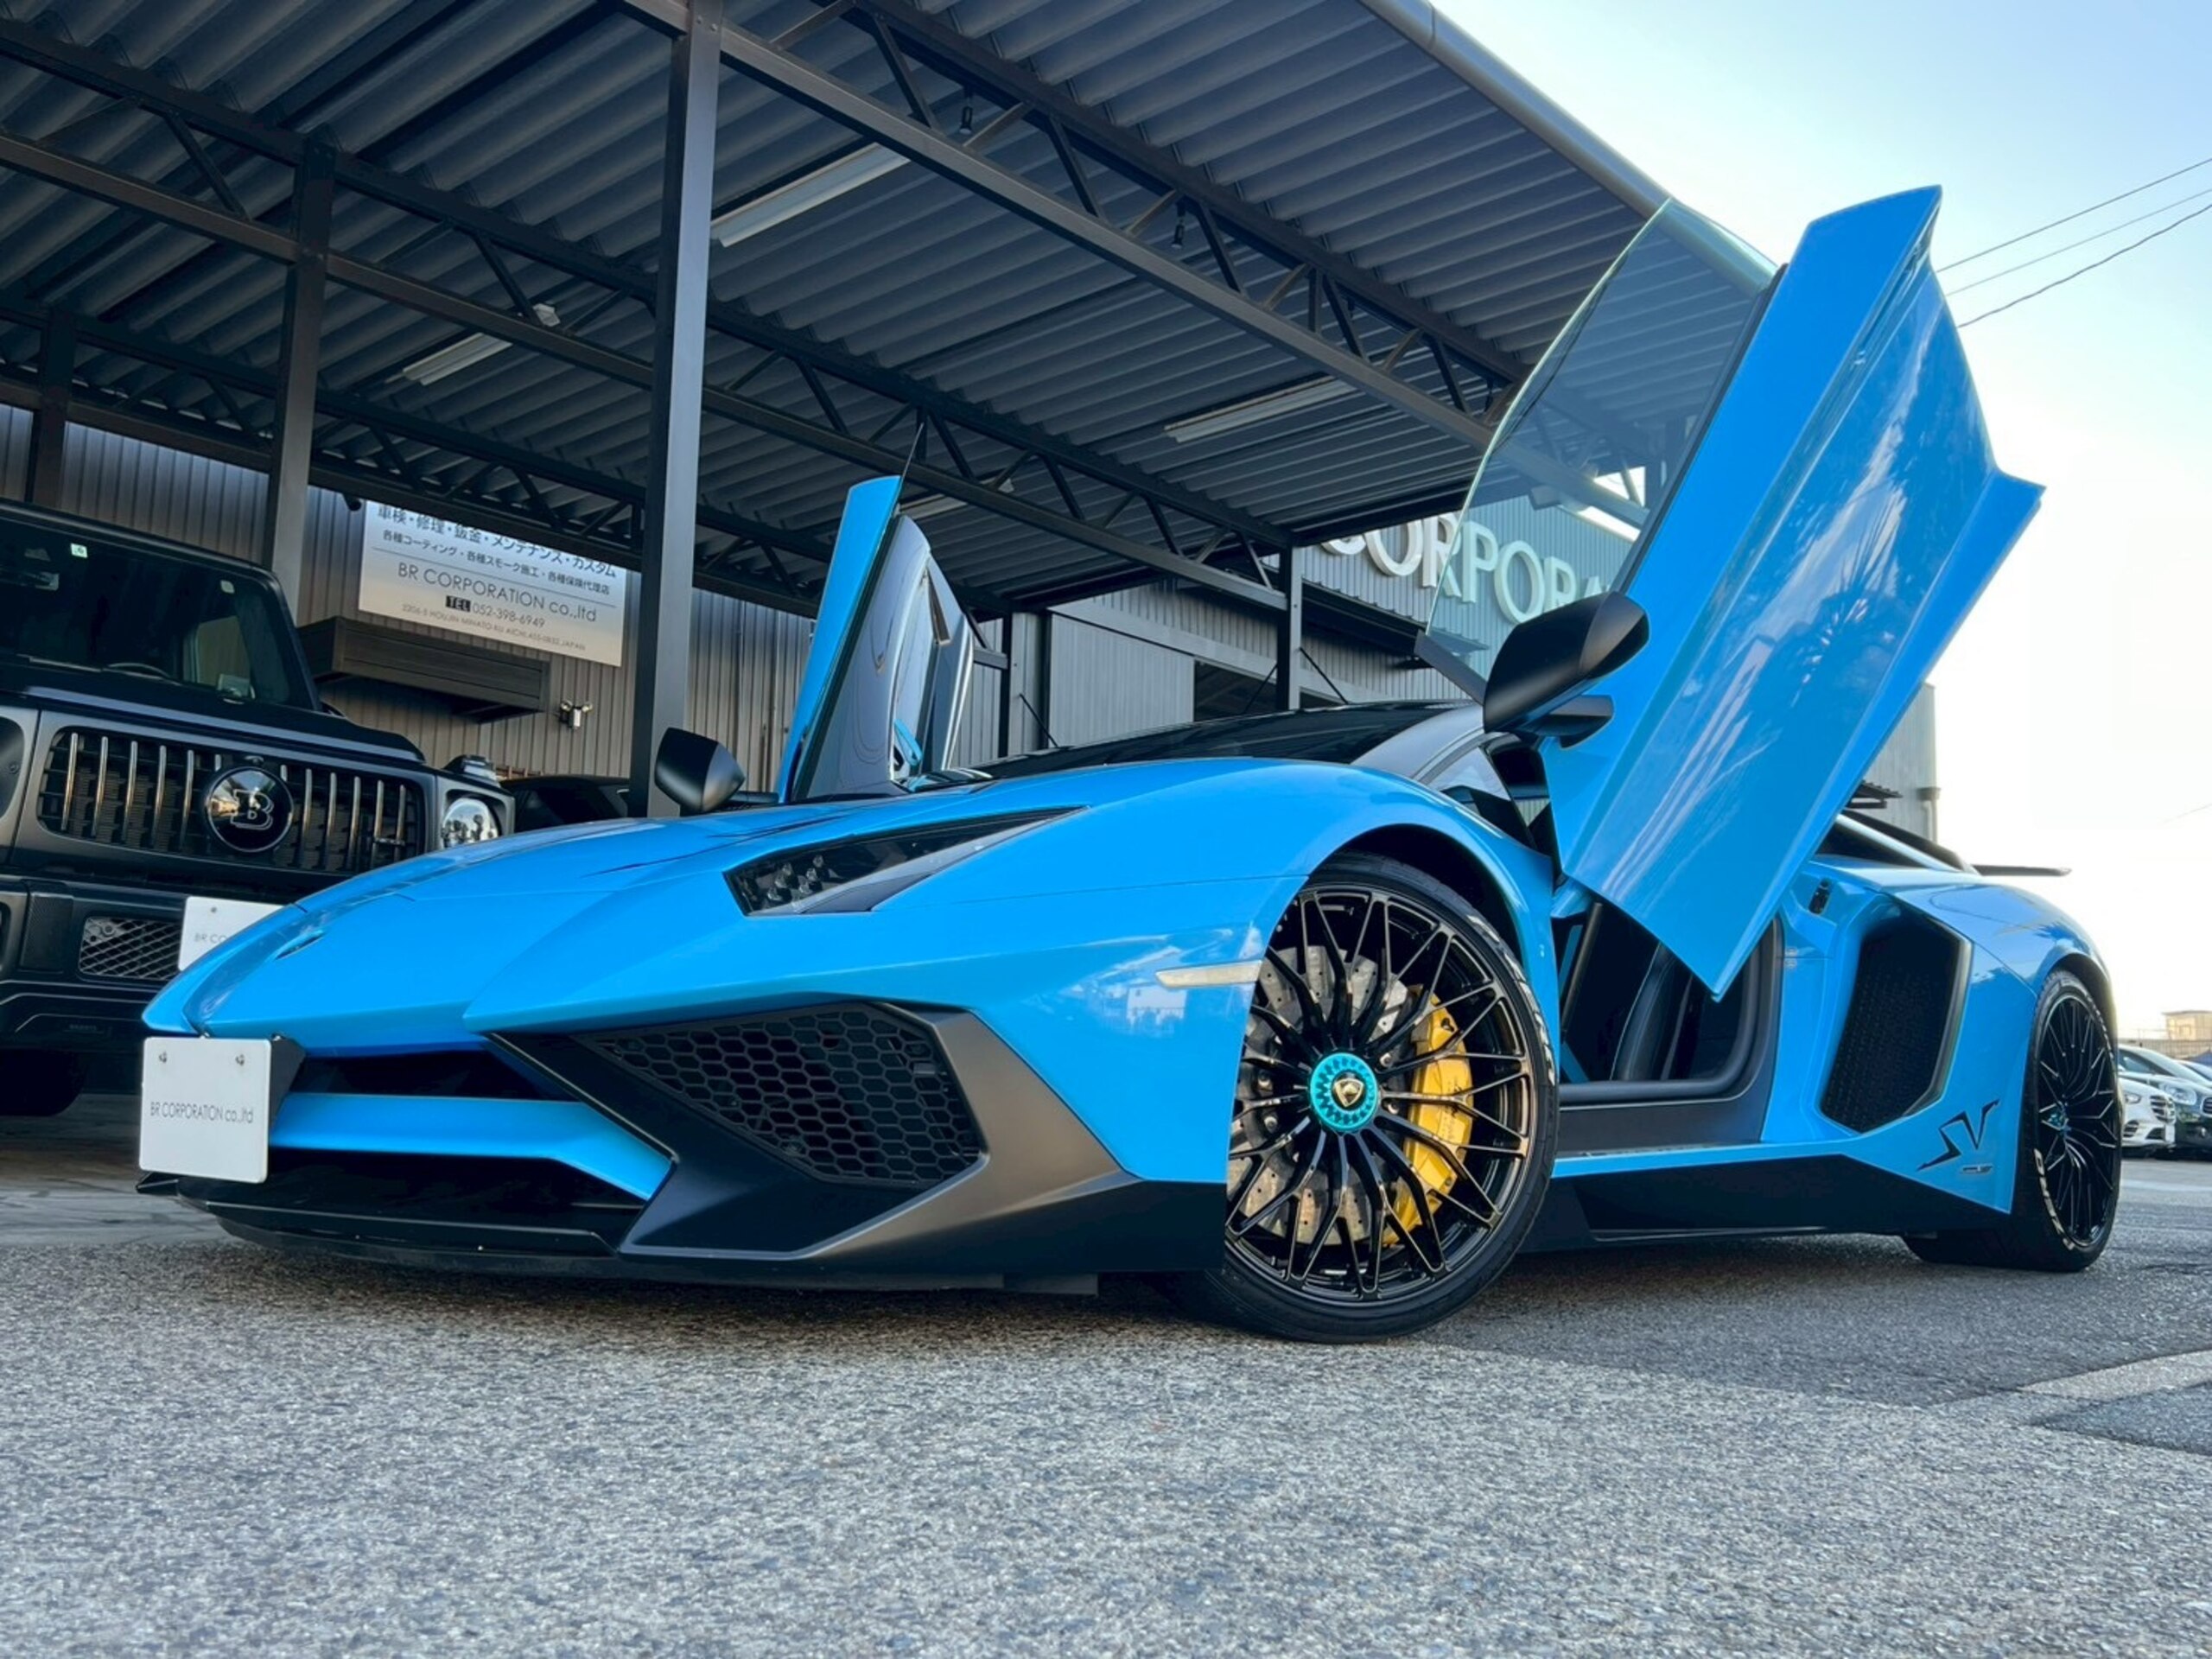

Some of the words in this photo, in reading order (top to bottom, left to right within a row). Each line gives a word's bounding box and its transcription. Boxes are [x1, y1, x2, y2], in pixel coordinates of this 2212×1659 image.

[398, 562, 419, 582] BR
[423, 568, 545, 609] CORPORATION
[447, 595, 471, 613] TEL
[473, 602, 545, 628] 052-398-6949
[150, 1101, 162, 1117] BR
[162, 1102, 224, 1122] CORPORATION
